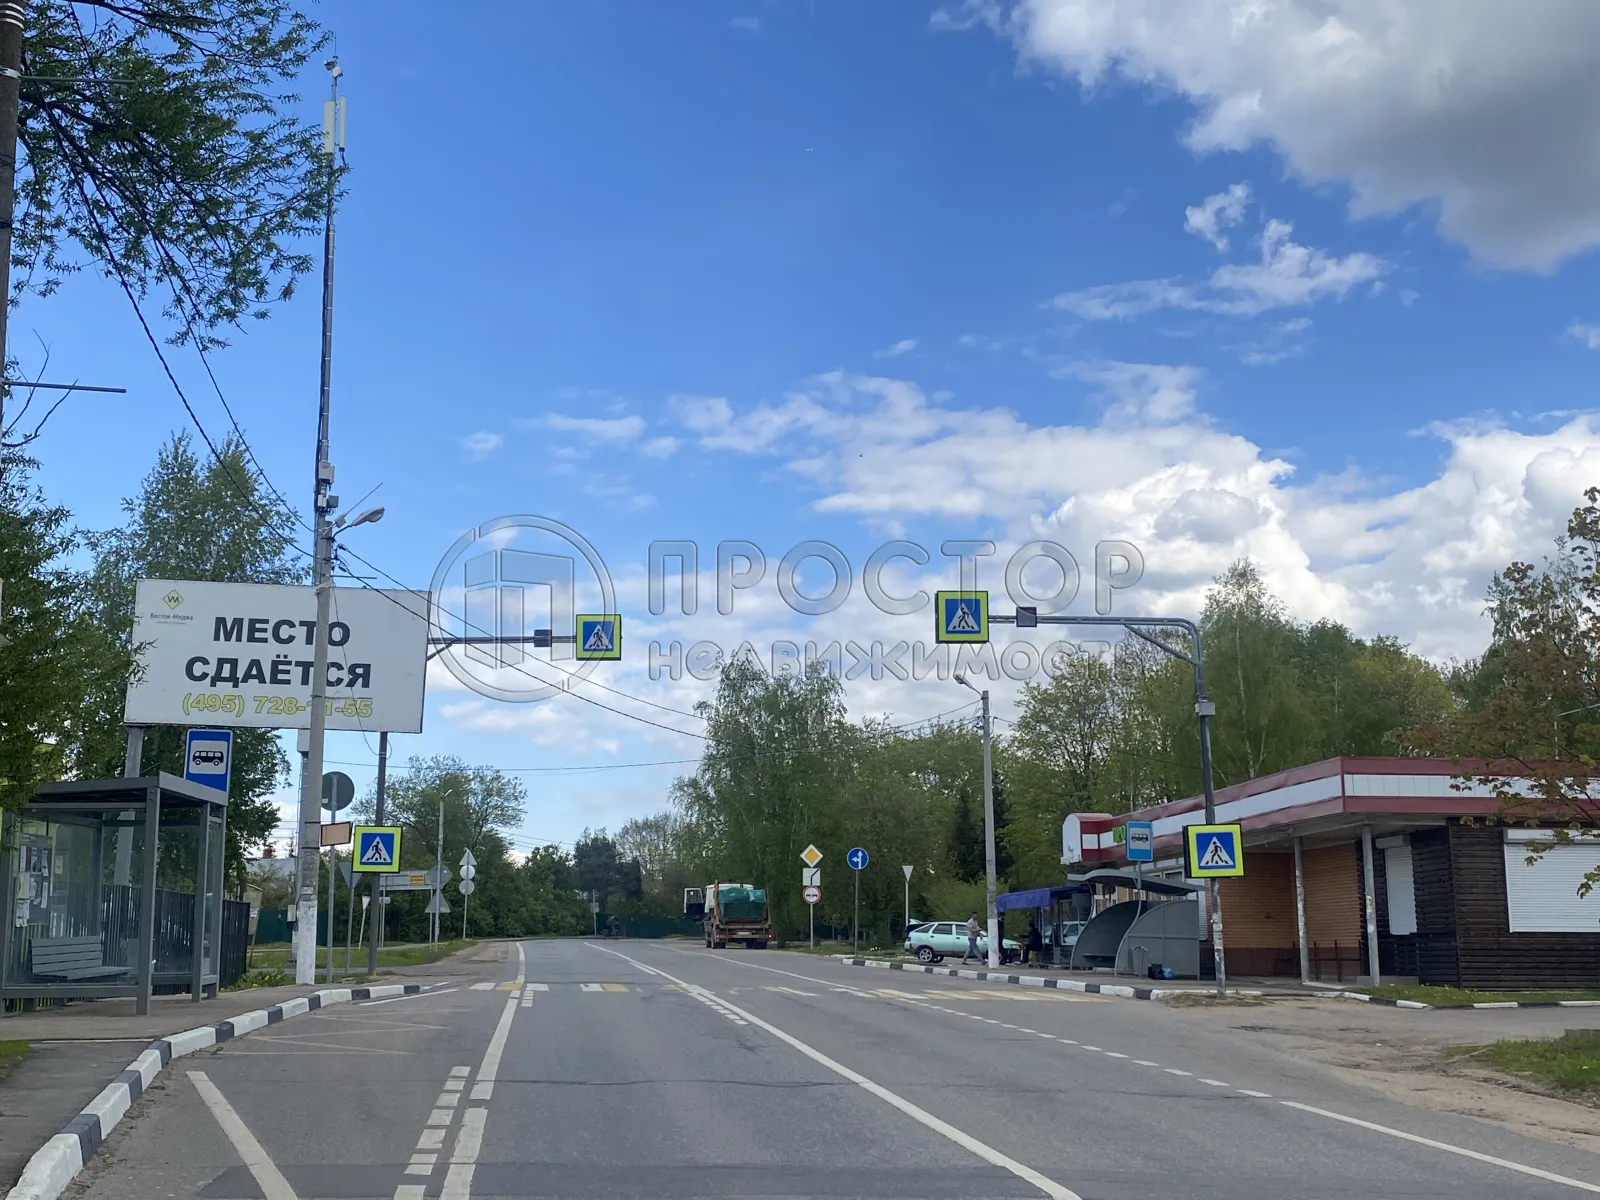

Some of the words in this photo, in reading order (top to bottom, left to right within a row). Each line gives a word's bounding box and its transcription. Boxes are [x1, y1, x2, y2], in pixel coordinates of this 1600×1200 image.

[213, 616, 350, 646] МЕСТО
[185, 654, 372, 688] СДАЁТСЯ
[182, 693, 246, 717] (495)
[253, 696, 373, 718] 728-1-55
